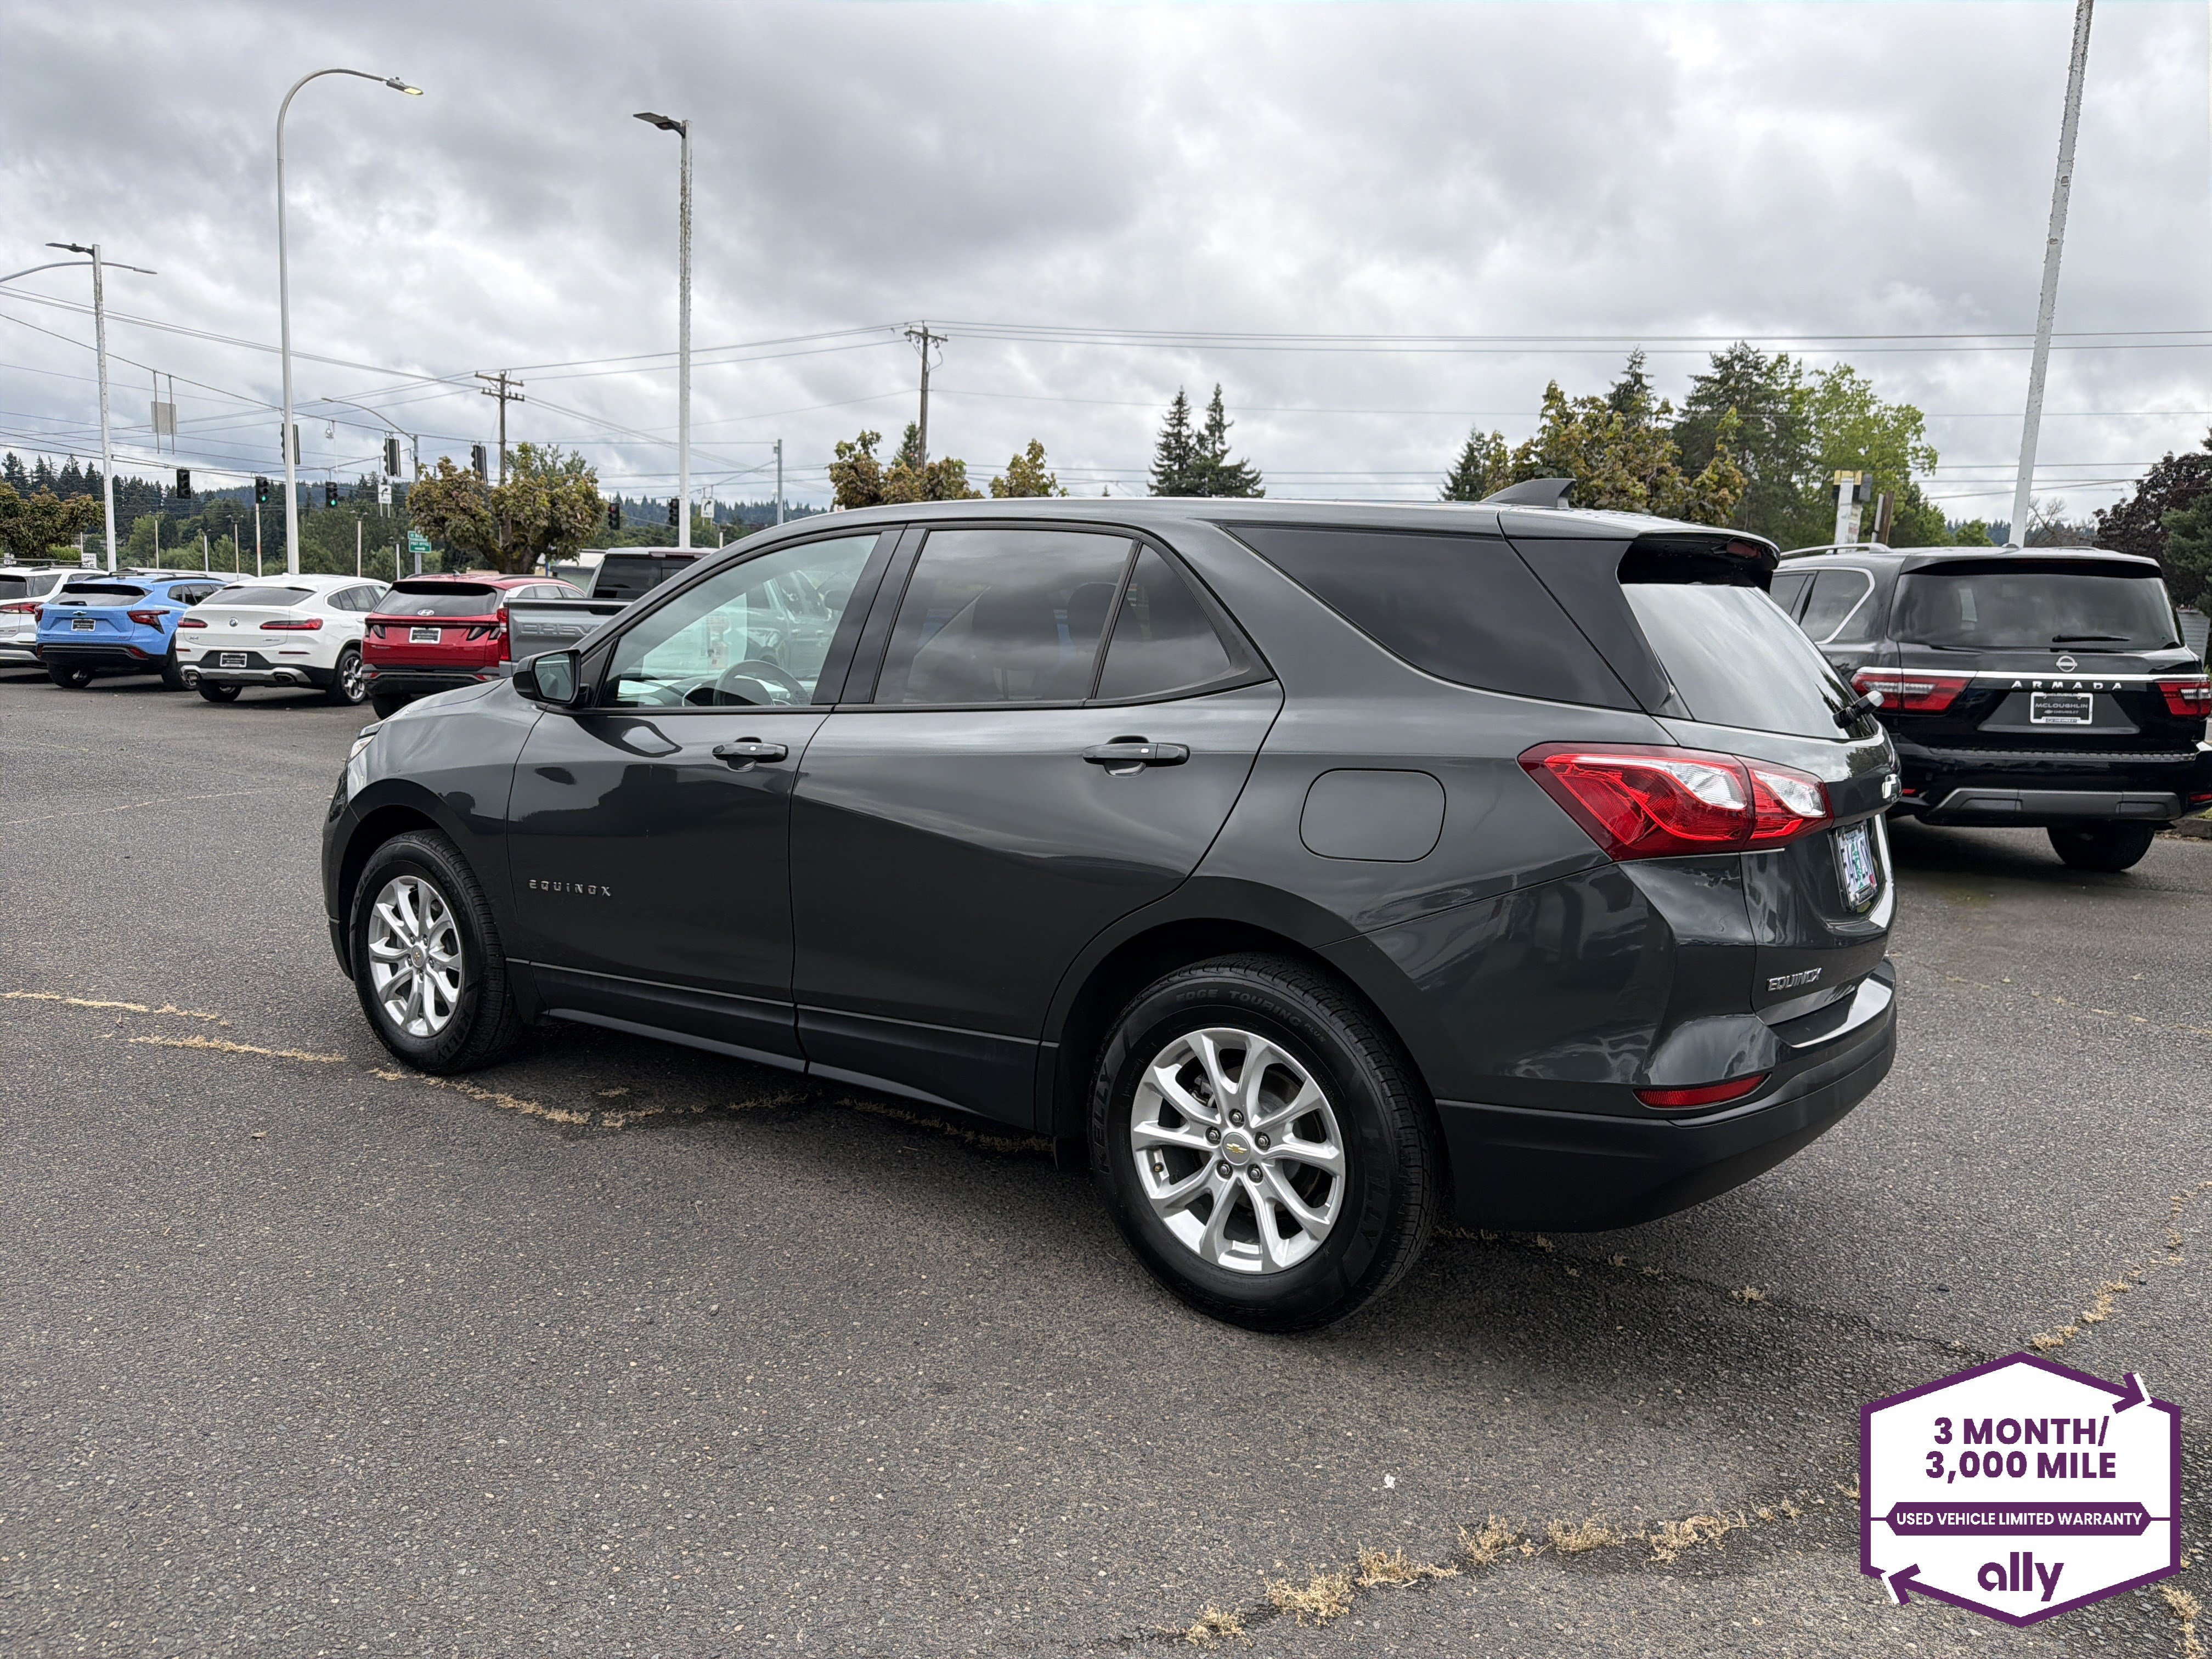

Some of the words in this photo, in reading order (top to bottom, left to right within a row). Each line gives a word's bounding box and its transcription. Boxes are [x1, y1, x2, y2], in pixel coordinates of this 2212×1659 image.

[2011, 680, 2121, 691] ARMADA
[529, 879, 611, 896] EQUINOX
[1768, 968, 1821, 991] EQUINOX
[1176, 989, 1218, 1002] EDGE
[1229, 990, 1301, 1027] TOURING
[1094, 1062, 1110, 1174] KELLY
